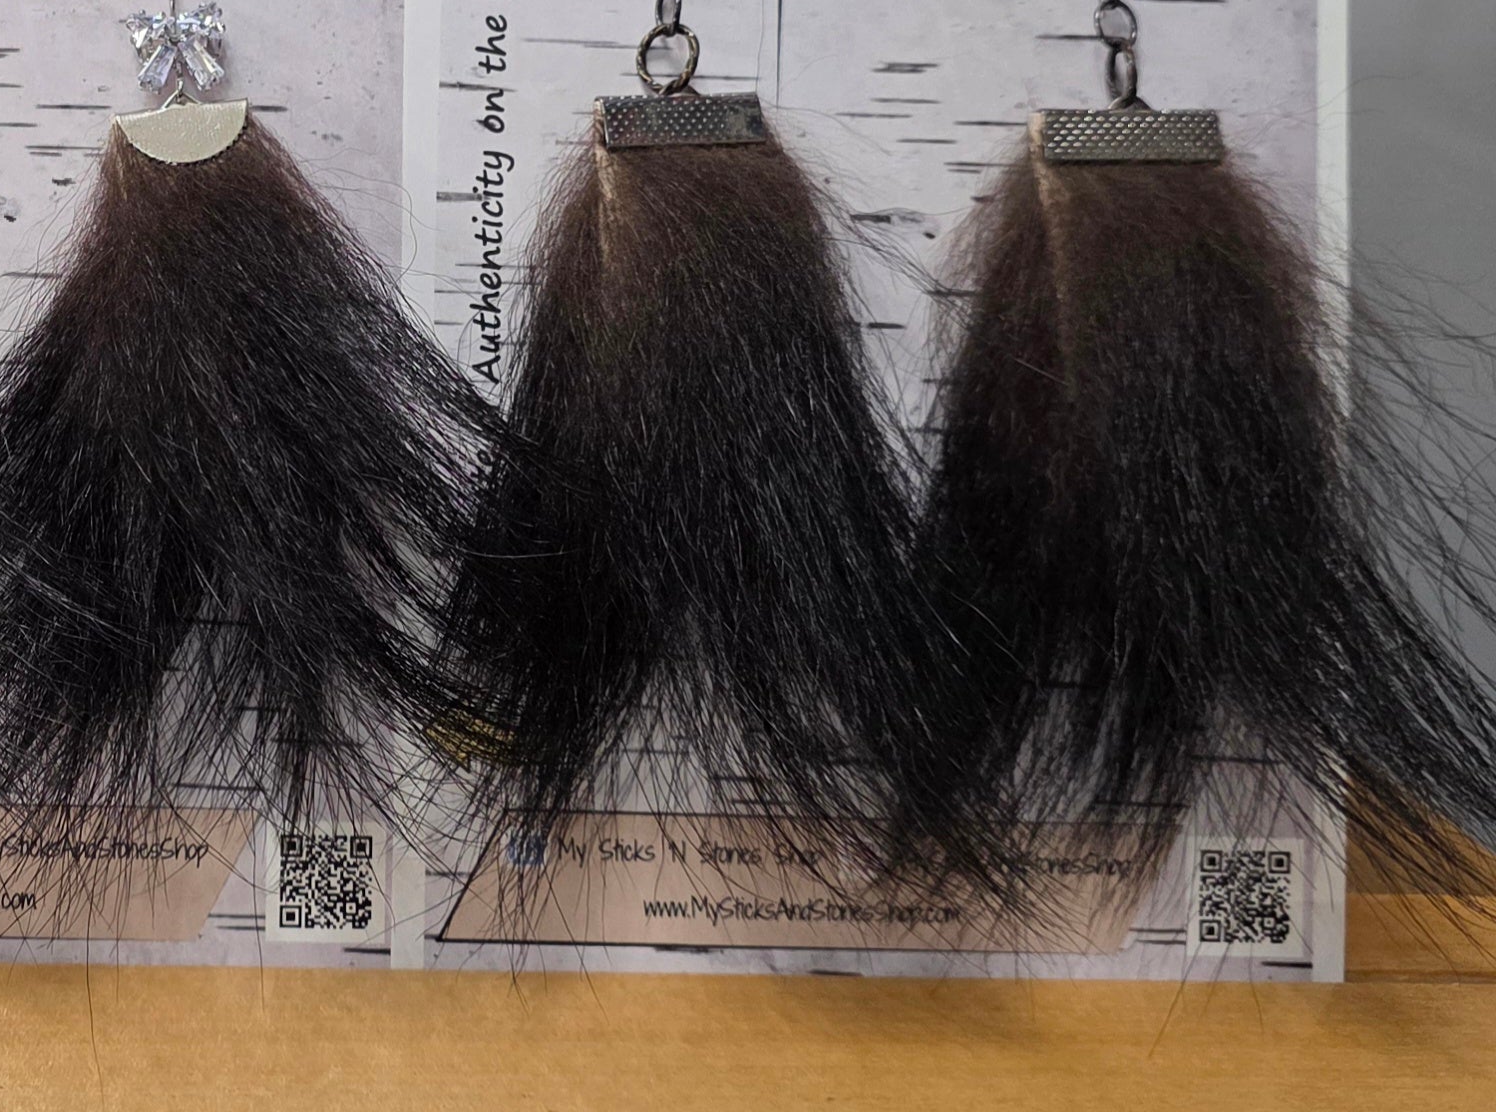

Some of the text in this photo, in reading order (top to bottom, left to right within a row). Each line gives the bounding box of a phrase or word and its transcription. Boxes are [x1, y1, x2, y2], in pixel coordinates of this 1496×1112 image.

[475, 14, 507, 78] the
[480, 88, 505, 133] on
[471, 148, 515, 384] Authenticity
[557, 839, 587, 868] My
[599, 839, 655, 862] Sticks
[699, 841, 761, 865] Stones
